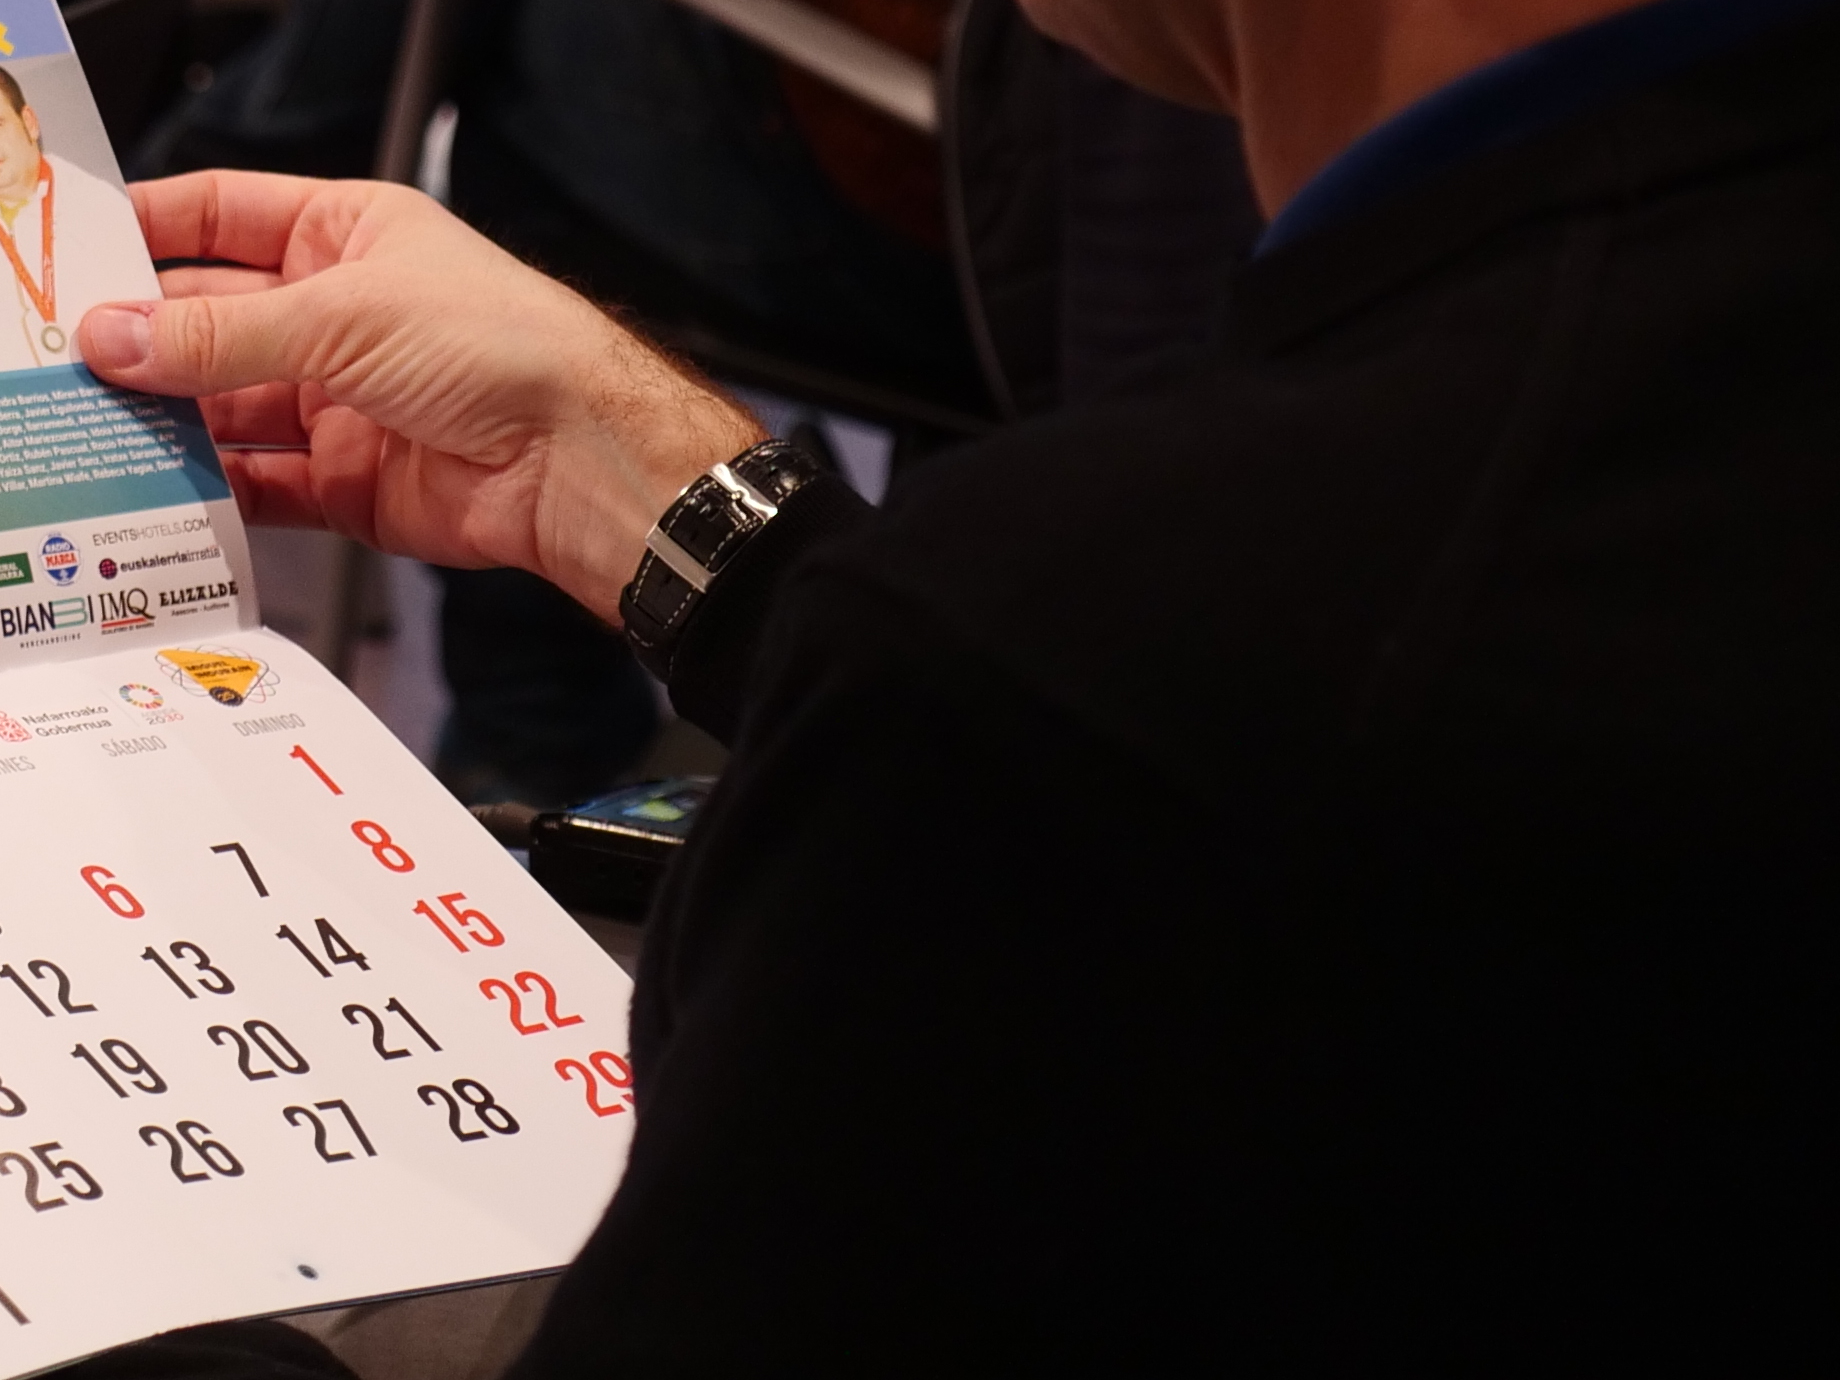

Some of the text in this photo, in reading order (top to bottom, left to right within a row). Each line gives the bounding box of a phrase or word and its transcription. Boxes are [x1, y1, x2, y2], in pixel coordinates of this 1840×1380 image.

[43, 540, 71, 554] RADIO
[92, 517, 213, 546] EVENTSHOTELS.COM
[44, 551, 78, 567] MARCA
[99, 587, 157, 621] IMQ
[159, 580, 240, 607] ELIZALDE
[21, 703, 109, 727] Nafarroako
[34, 717, 112, 739] Gobernua
[101, 734, 168, 759] SÁBADO
[233, 712, 307, 738] DOMINGO
[288, 744, 344, 795] 1
[80, 865, 145, 919] 6
[210, 842, 270, 898] 7
[351, 820, 416, 873] 8
[140, 940, 236, 1000] 13
[275, 917, 372, 978] 14
[412, 892, 505, 953] 15
[70, 1038, 168, 1098] 19
[207, 1019, 310, 1081] 20
[342, 996, 444, 1061] 21
[478, 970, 585, 1036] 22
[139, 1120, 245, 1184] 26
[282, 1098, 378, 1163] 27
[417, 1078, 520, 1142] 28
